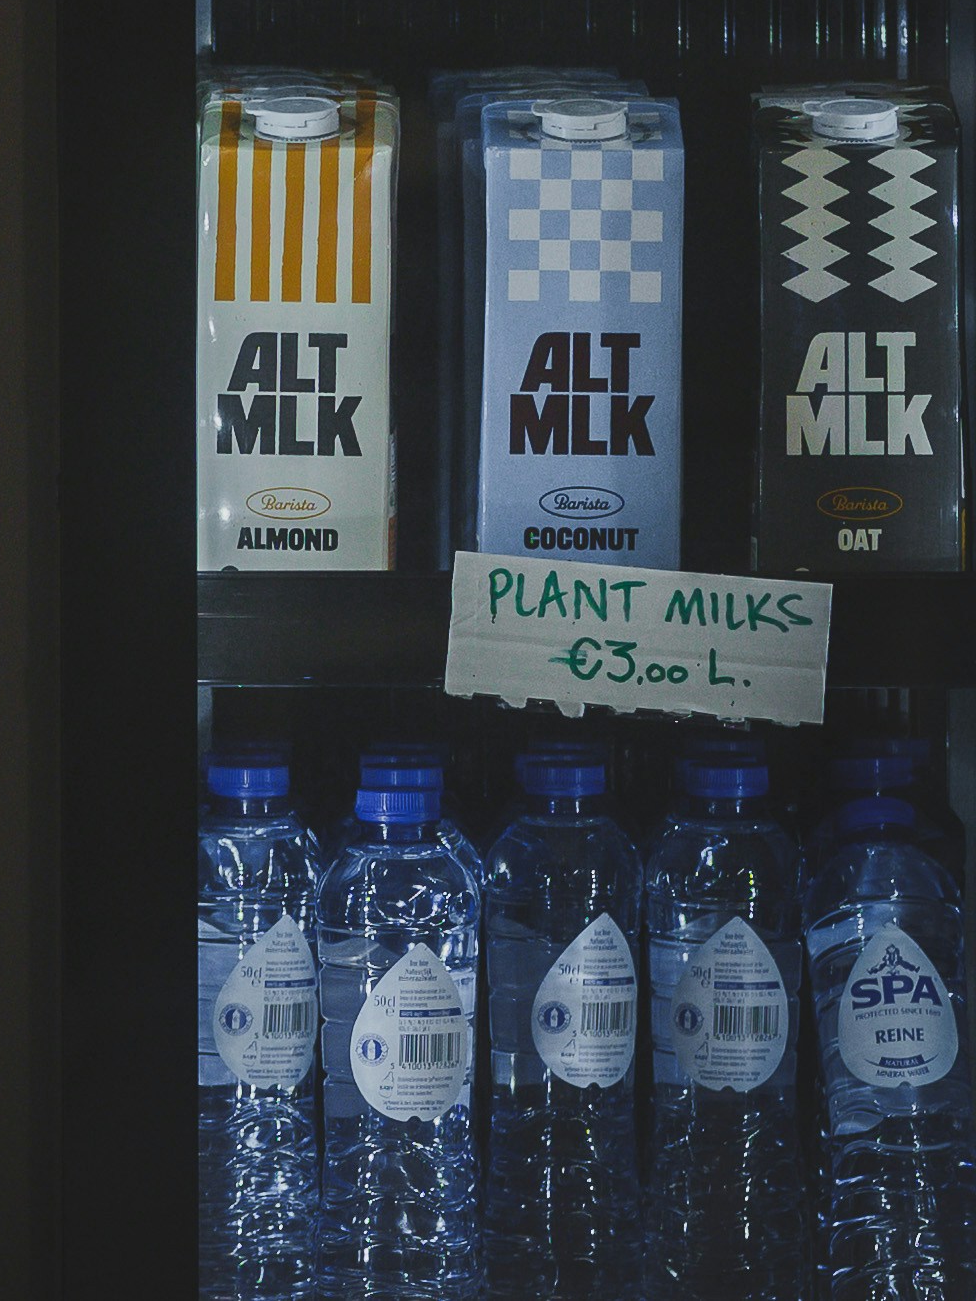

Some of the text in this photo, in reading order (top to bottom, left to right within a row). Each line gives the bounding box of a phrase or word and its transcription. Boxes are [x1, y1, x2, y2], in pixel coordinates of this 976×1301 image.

[227, 332, 348, 394] ALT
[519, 331, 641, 394] ALT
[795, 331, 917, 393] ALT
[216, 393, 363, 457] MLK
[509, 393, 656, 457] MLK
[786, 393, 934, 456] MLK
[262, 494, 318, 511] Barista
[554, 493, 611, 511] Barista
[832, 493, 889, 512] Barista
[237, 526, 339, 552] ALMOND
[524, 526, 640, 551] COCONUT
[837, 528, 883, 552] OAT
[488, 567, 814, 633] PLANT MILKS
[548, 636, 689, 686] €3.00
[558, 963, 581, 976] 50cl
[690, 965, 712, 978] 50cl
[374, 995, 396, 1007] 50cl
[850, 974, 943, 1010] SPA
[855, 1007, 923, 1021] PROTECTED SINCE
[875, 1027, 924, 1044] REINE
[876, 1068, 906, 1078] MINERAL
[885, 1058, 919, 1067] NATURAL
